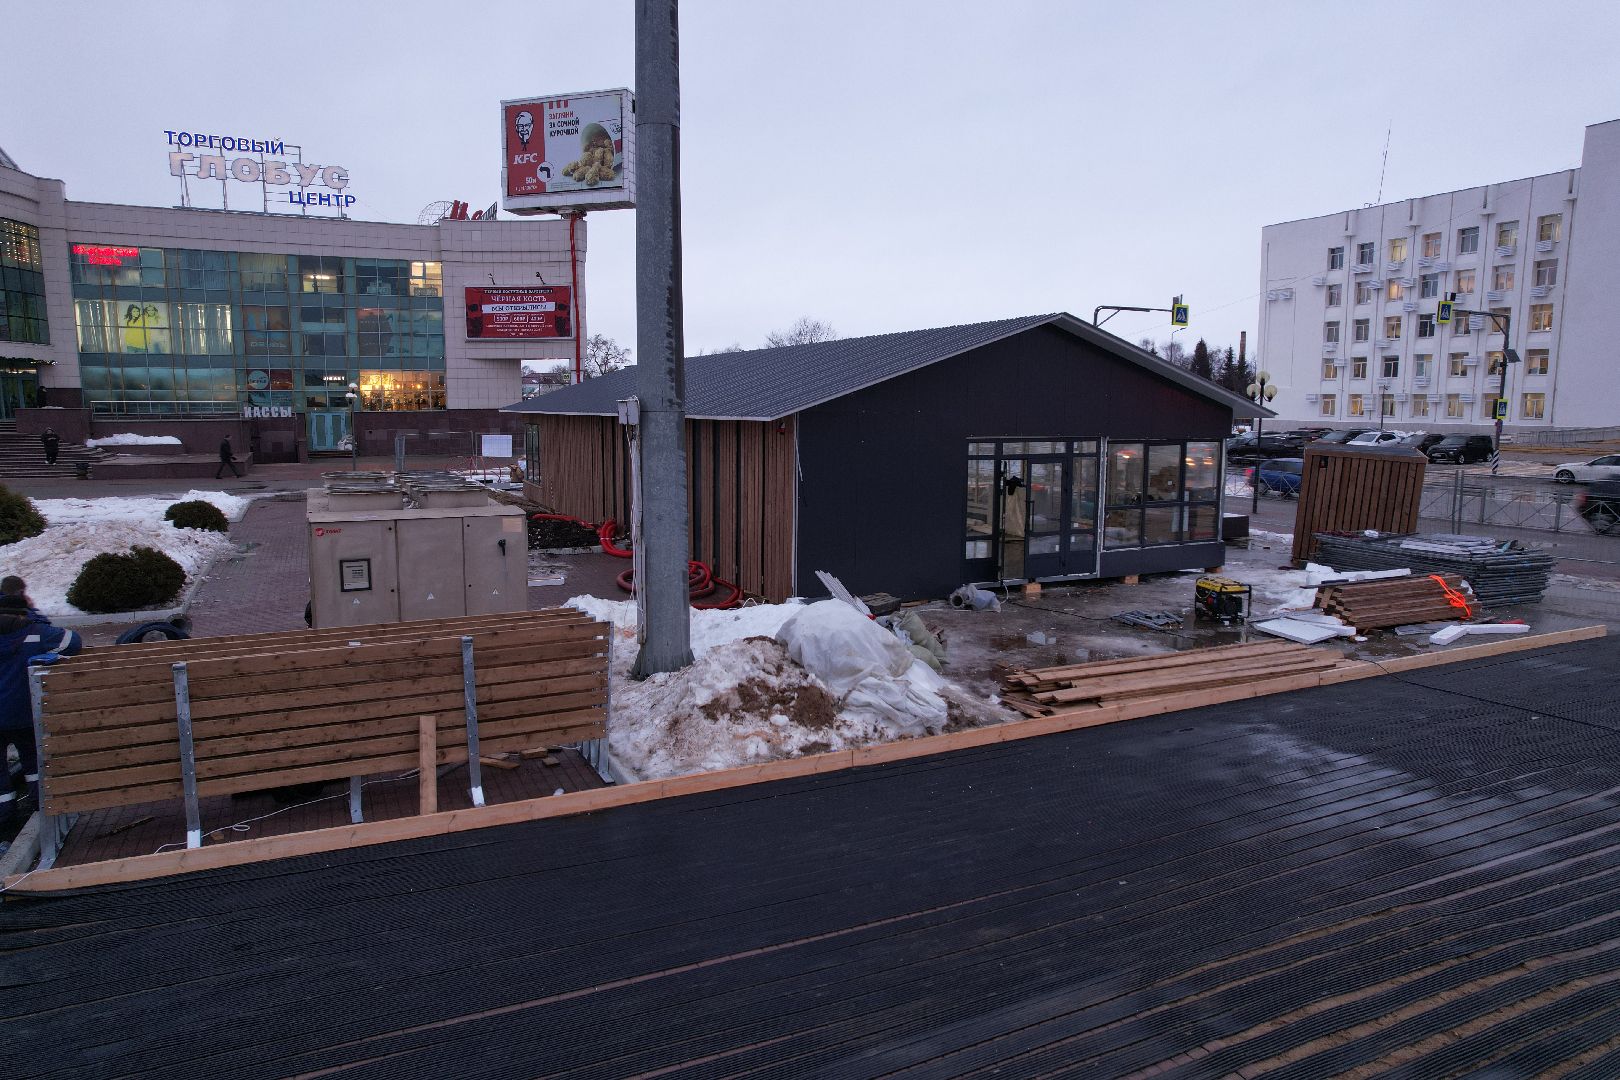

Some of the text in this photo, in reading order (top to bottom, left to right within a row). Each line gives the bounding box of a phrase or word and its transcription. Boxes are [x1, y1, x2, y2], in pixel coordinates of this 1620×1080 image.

[549, 117, 580, 129] ЗА СОЧНОЙ
[164, 130, 285, 156] ТОРГОВЫЙ
[513, 152, 538, 165] KFC
[168, 151, 350, 190] ГЛОБУС
[288, 190, 356, 208] ЦЕНТР
[243, 406, 292, 418] КАССЫ
